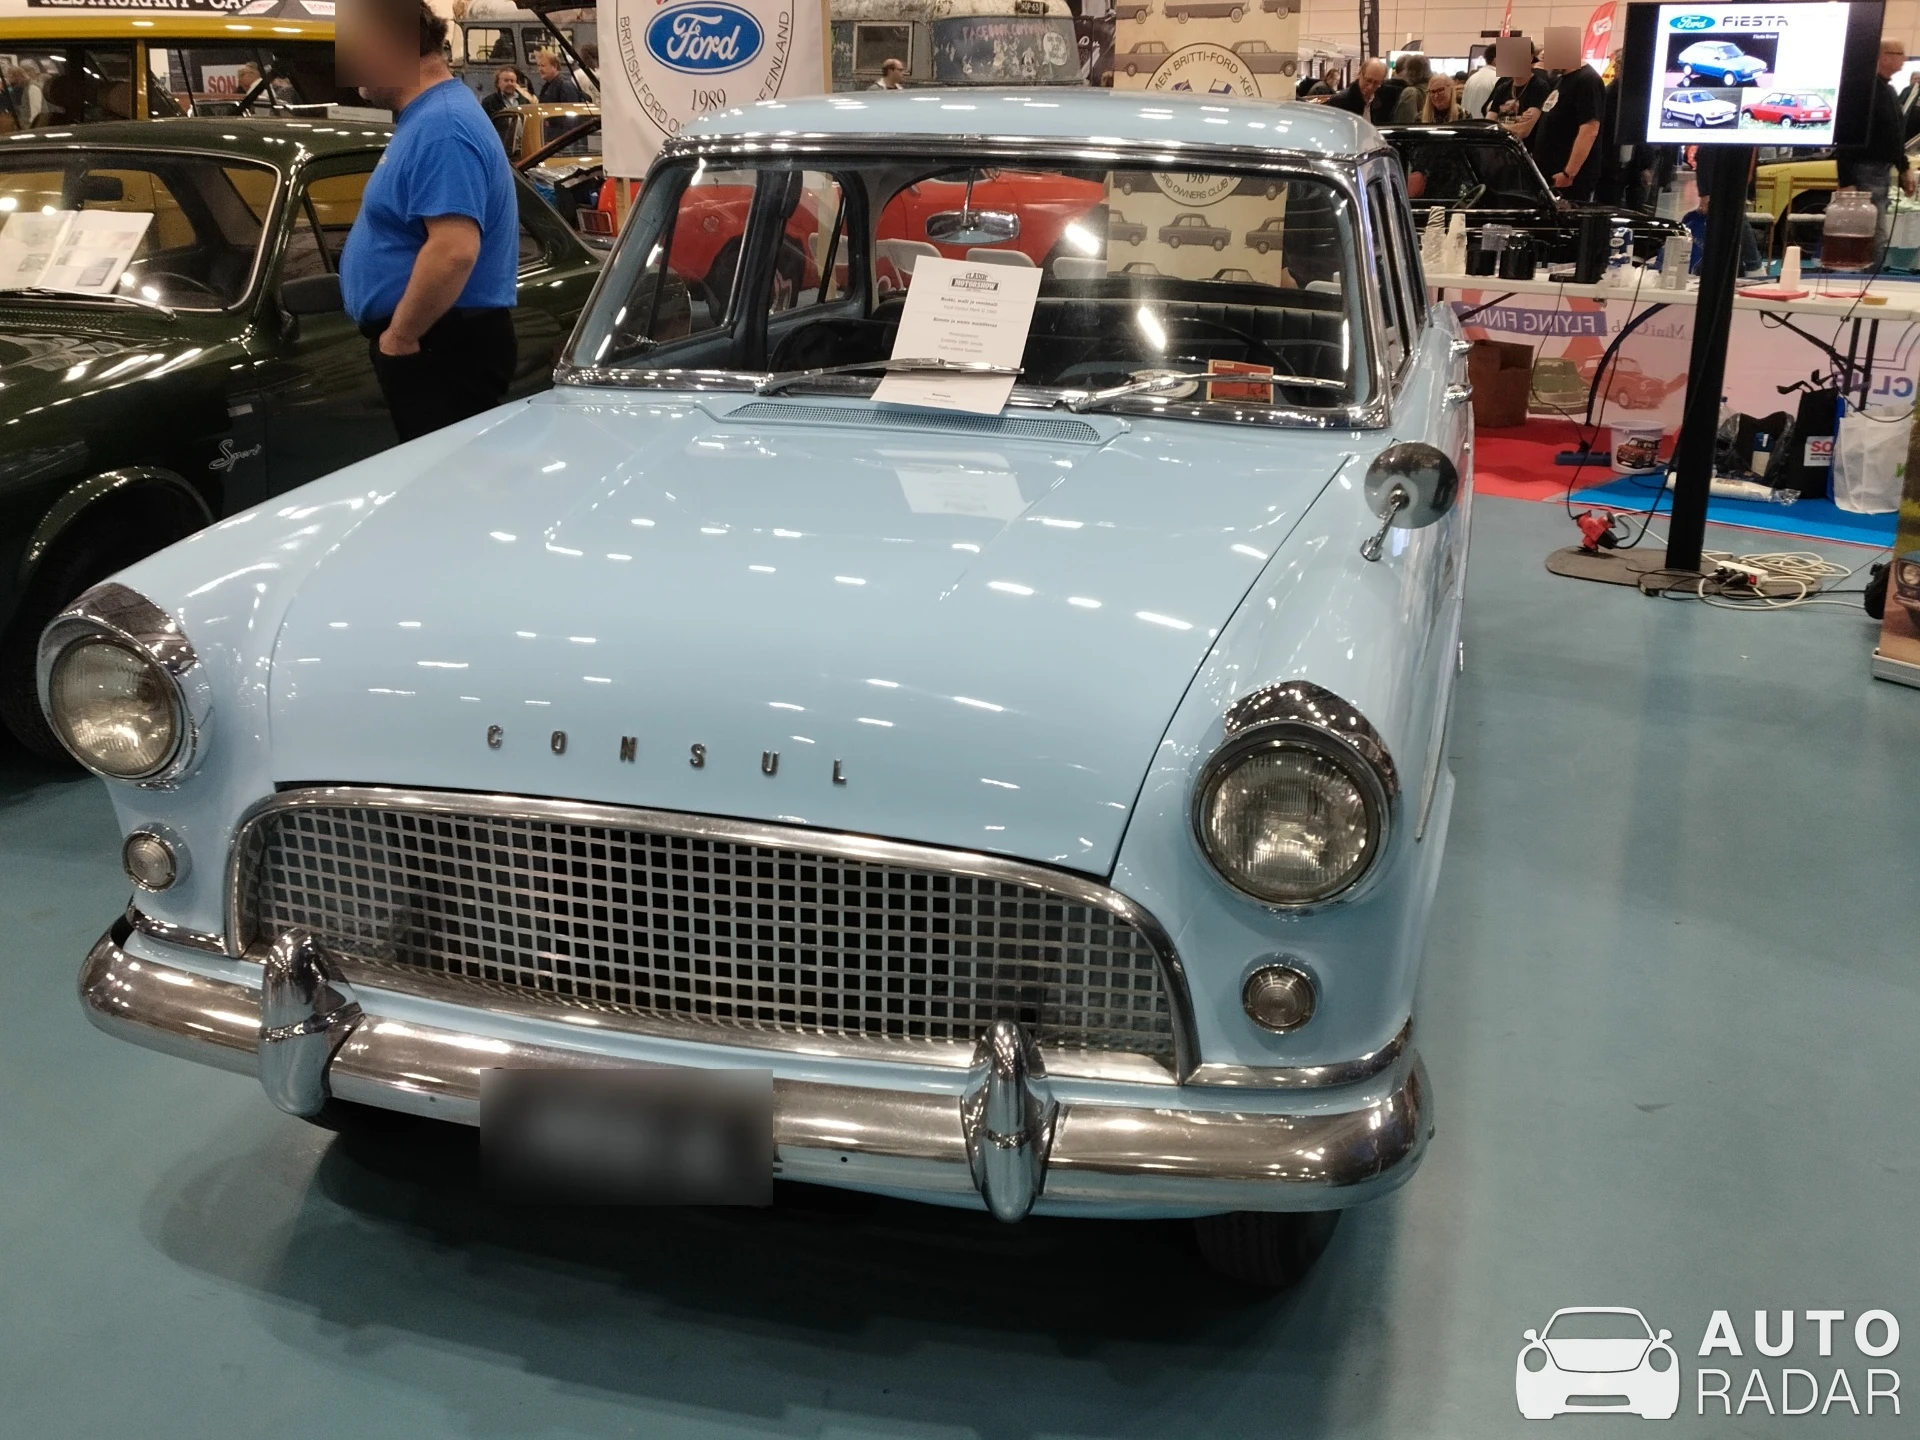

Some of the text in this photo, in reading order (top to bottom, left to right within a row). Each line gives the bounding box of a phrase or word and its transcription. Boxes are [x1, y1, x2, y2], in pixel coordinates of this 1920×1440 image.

[1677, 15, 1708, 30] Ford
[666, 13, 741, 60] Ford
[765, 11, 790, 92] FINLAND
[1173, 51, 1239, 75] BRITTI-FORD
[620, 16, 668, 124] BRITISH FORD
[208, 75, 236, 93] SON
[691, 88, 727, 112] 1989
[1173, 185, 1207, 199] OWNERS
[1208, 178, 1229, 197] CLUB
[954, 279, 996, 290] MOTORSHOW
[1810, 440, 1834, 453] SO
[486, 724, 848, 786] CONSUL
